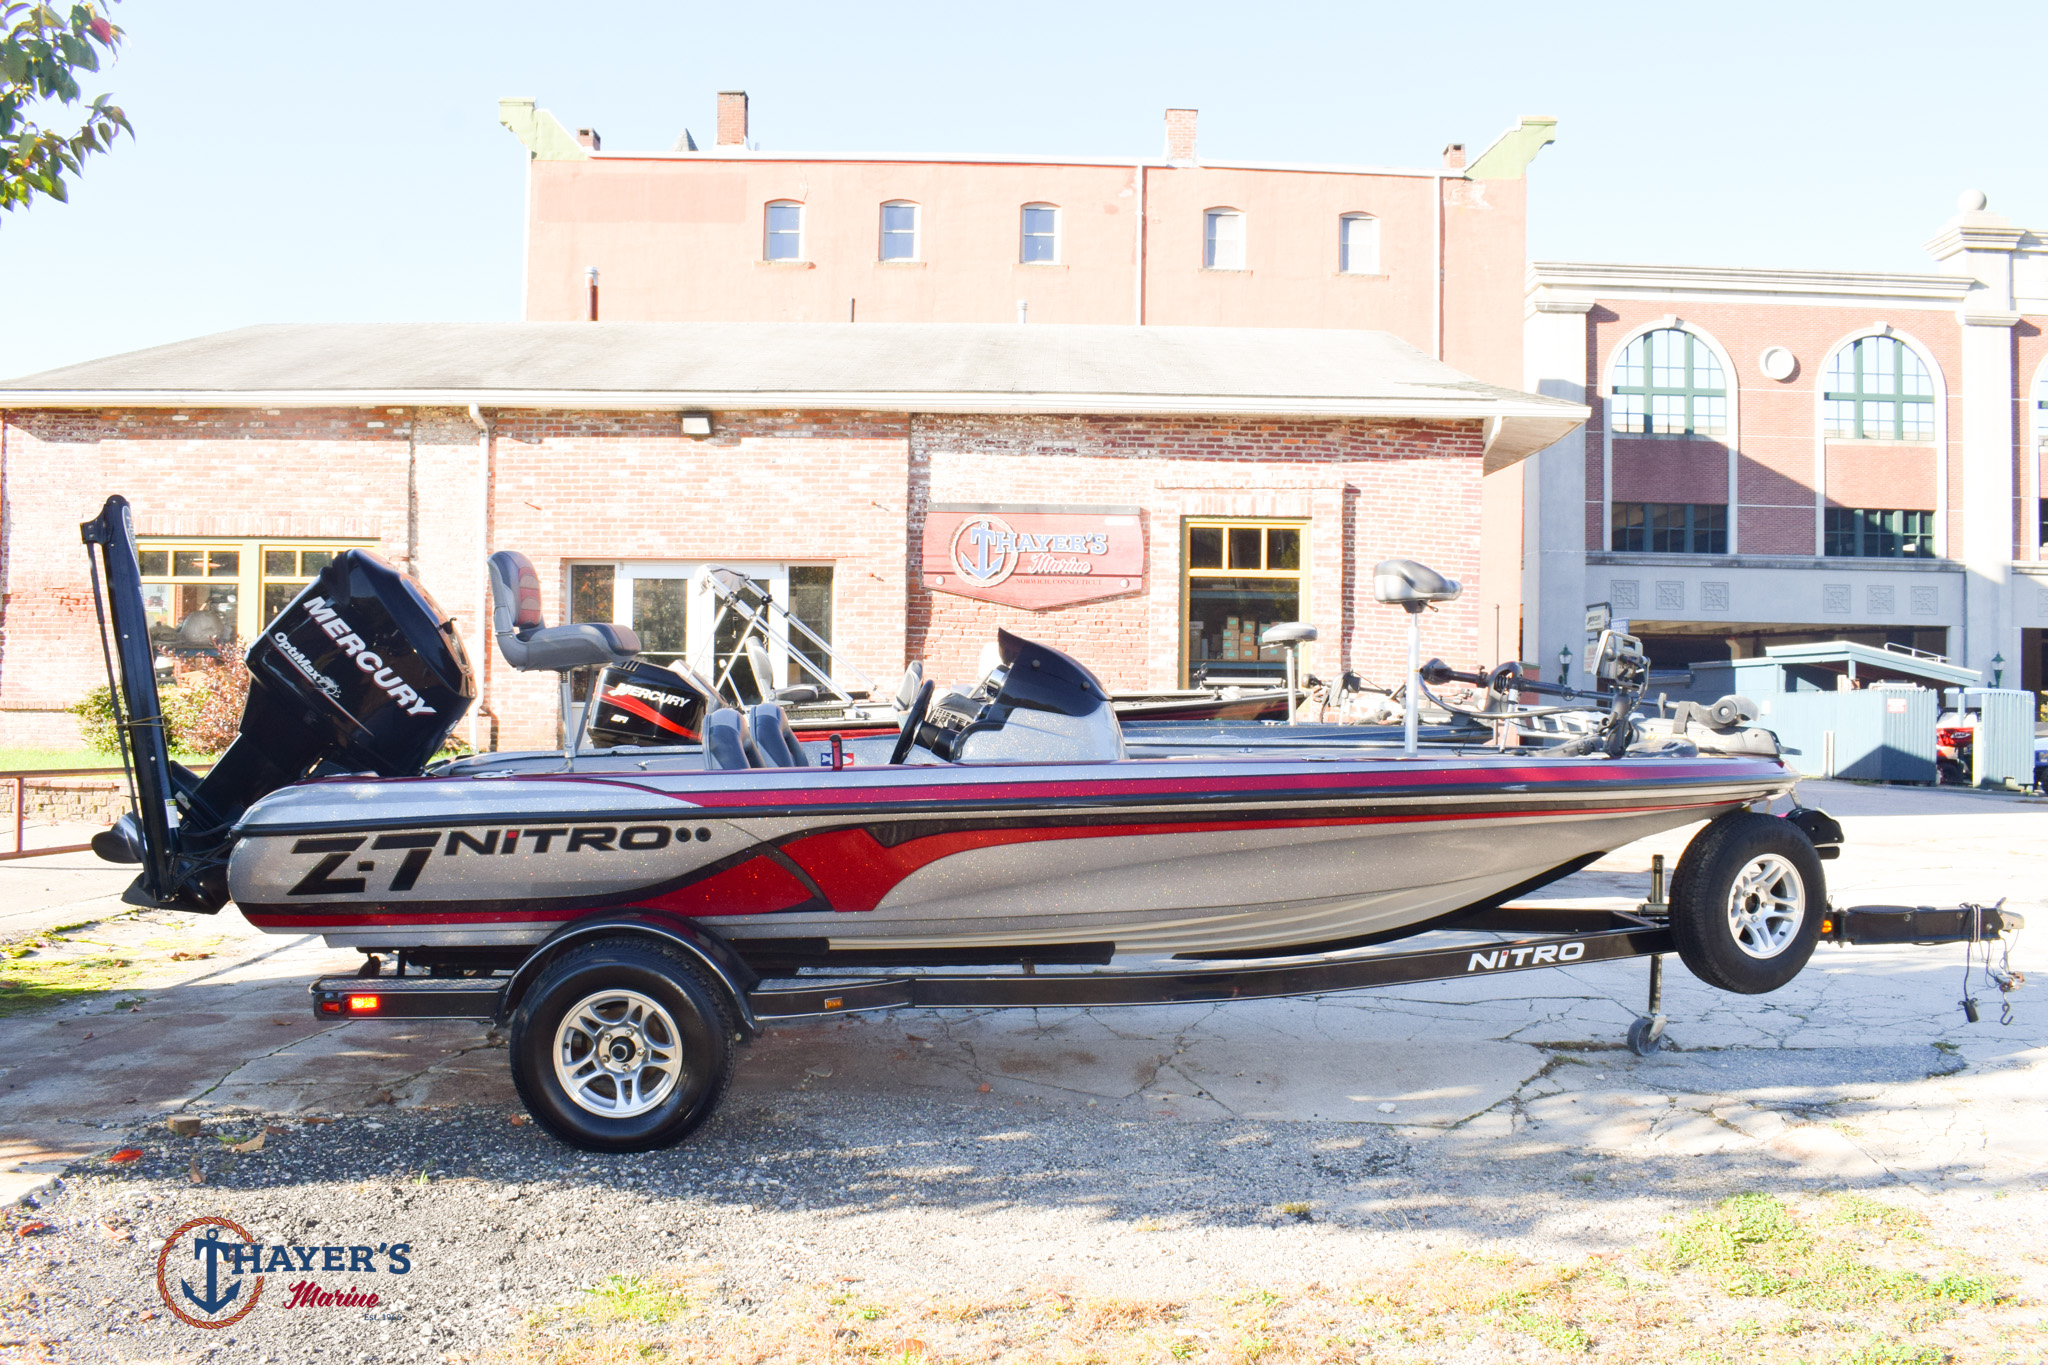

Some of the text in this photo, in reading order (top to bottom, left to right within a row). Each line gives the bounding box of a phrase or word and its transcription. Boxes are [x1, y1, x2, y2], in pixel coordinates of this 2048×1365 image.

[971, 526, 1107, 572] THAYER'S
[1029, 554, 1091, 573] Marine
[1052, 578, 1102, 586] CONNECTICUT
[274, 632, 321, 681] OptiMax
[303, 596, 437, 716] MERCURY
[608, 682, 691, 707] MERCURY
